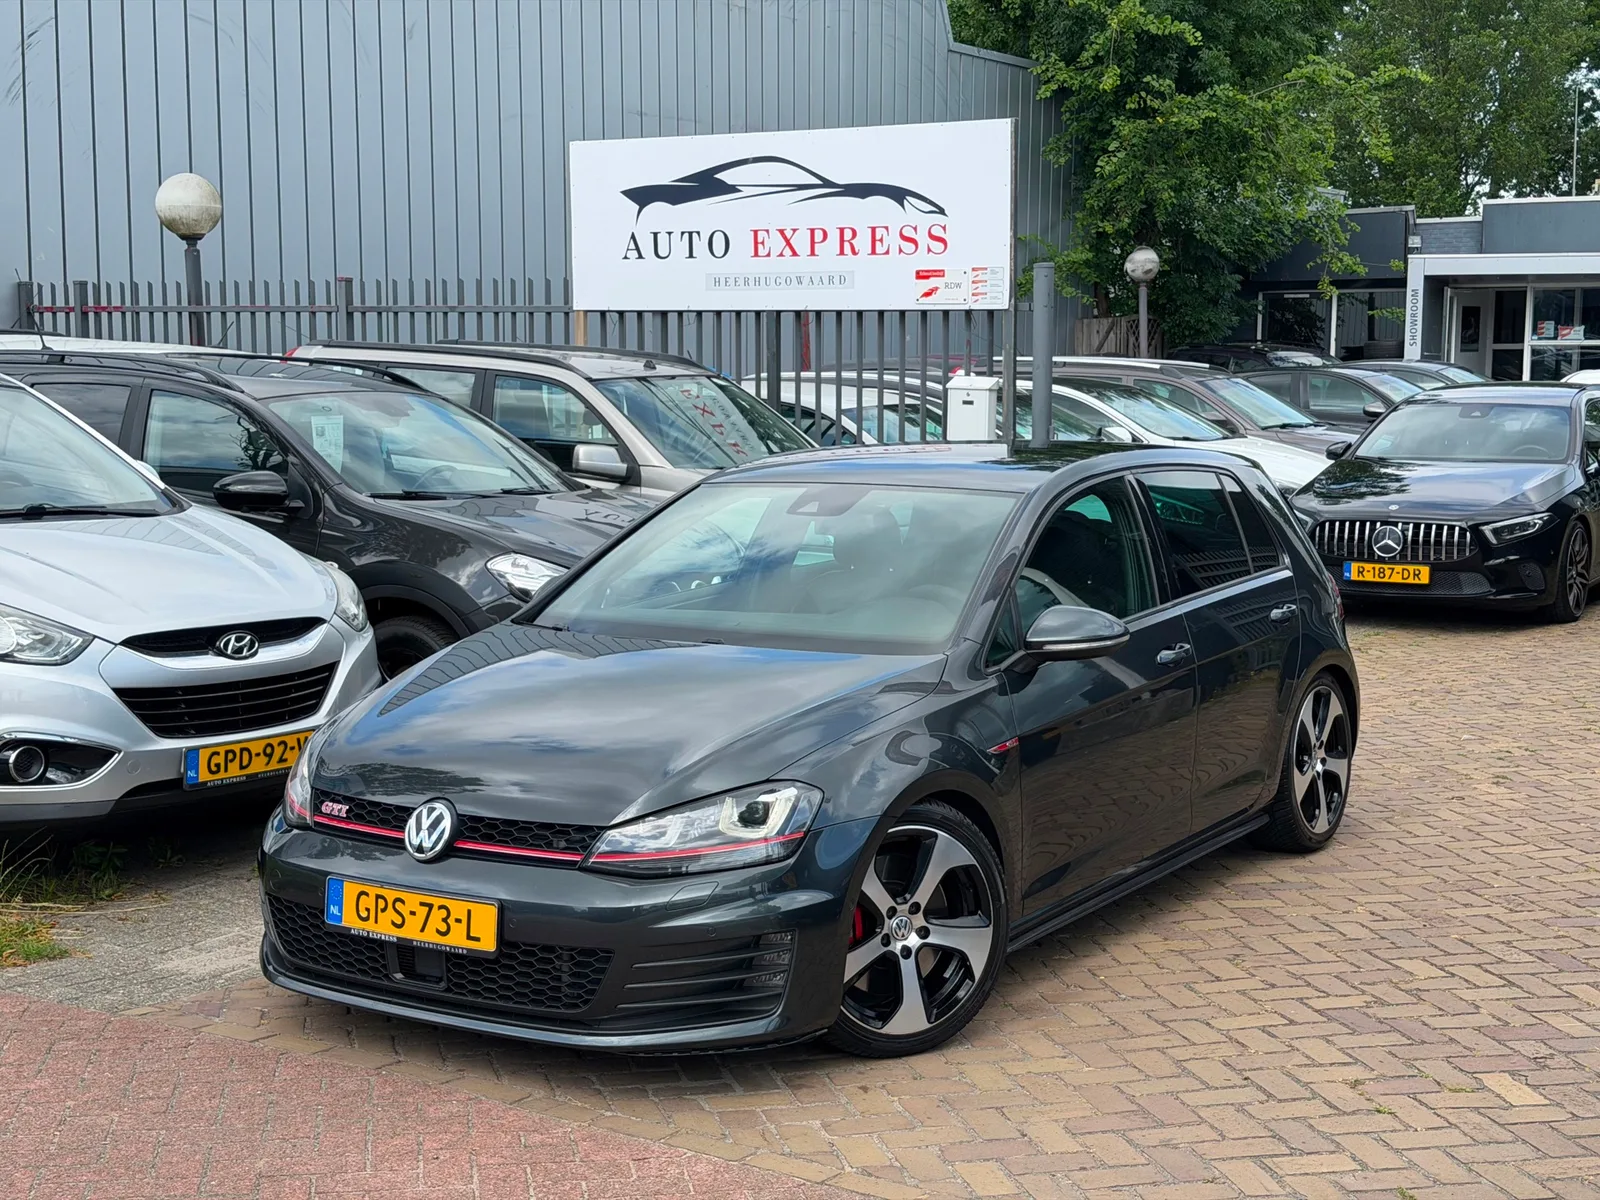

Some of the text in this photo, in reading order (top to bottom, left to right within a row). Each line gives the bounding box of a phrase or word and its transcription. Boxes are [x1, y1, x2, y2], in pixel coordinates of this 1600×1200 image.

[622, 223, 949, 260] AUTO EXPRESS
[713, 274, 847, 288] HEERHUGOWAARD
[944, 281, 963, 290] RDW
[1409, 288, 1420, 347] SHOWROOM
[1357, 565, 1422, 581] R-187-DR
[187, 769, 198, 778] NL
[206, 779, 222, 787] AUTO
[321, 801, 349, 818] GTI
[329, 904, 341, 916] NL
[355, 890, 481, 943] GPS-73-L
[350, 928, 398, 943] AUTO EXPRESS
